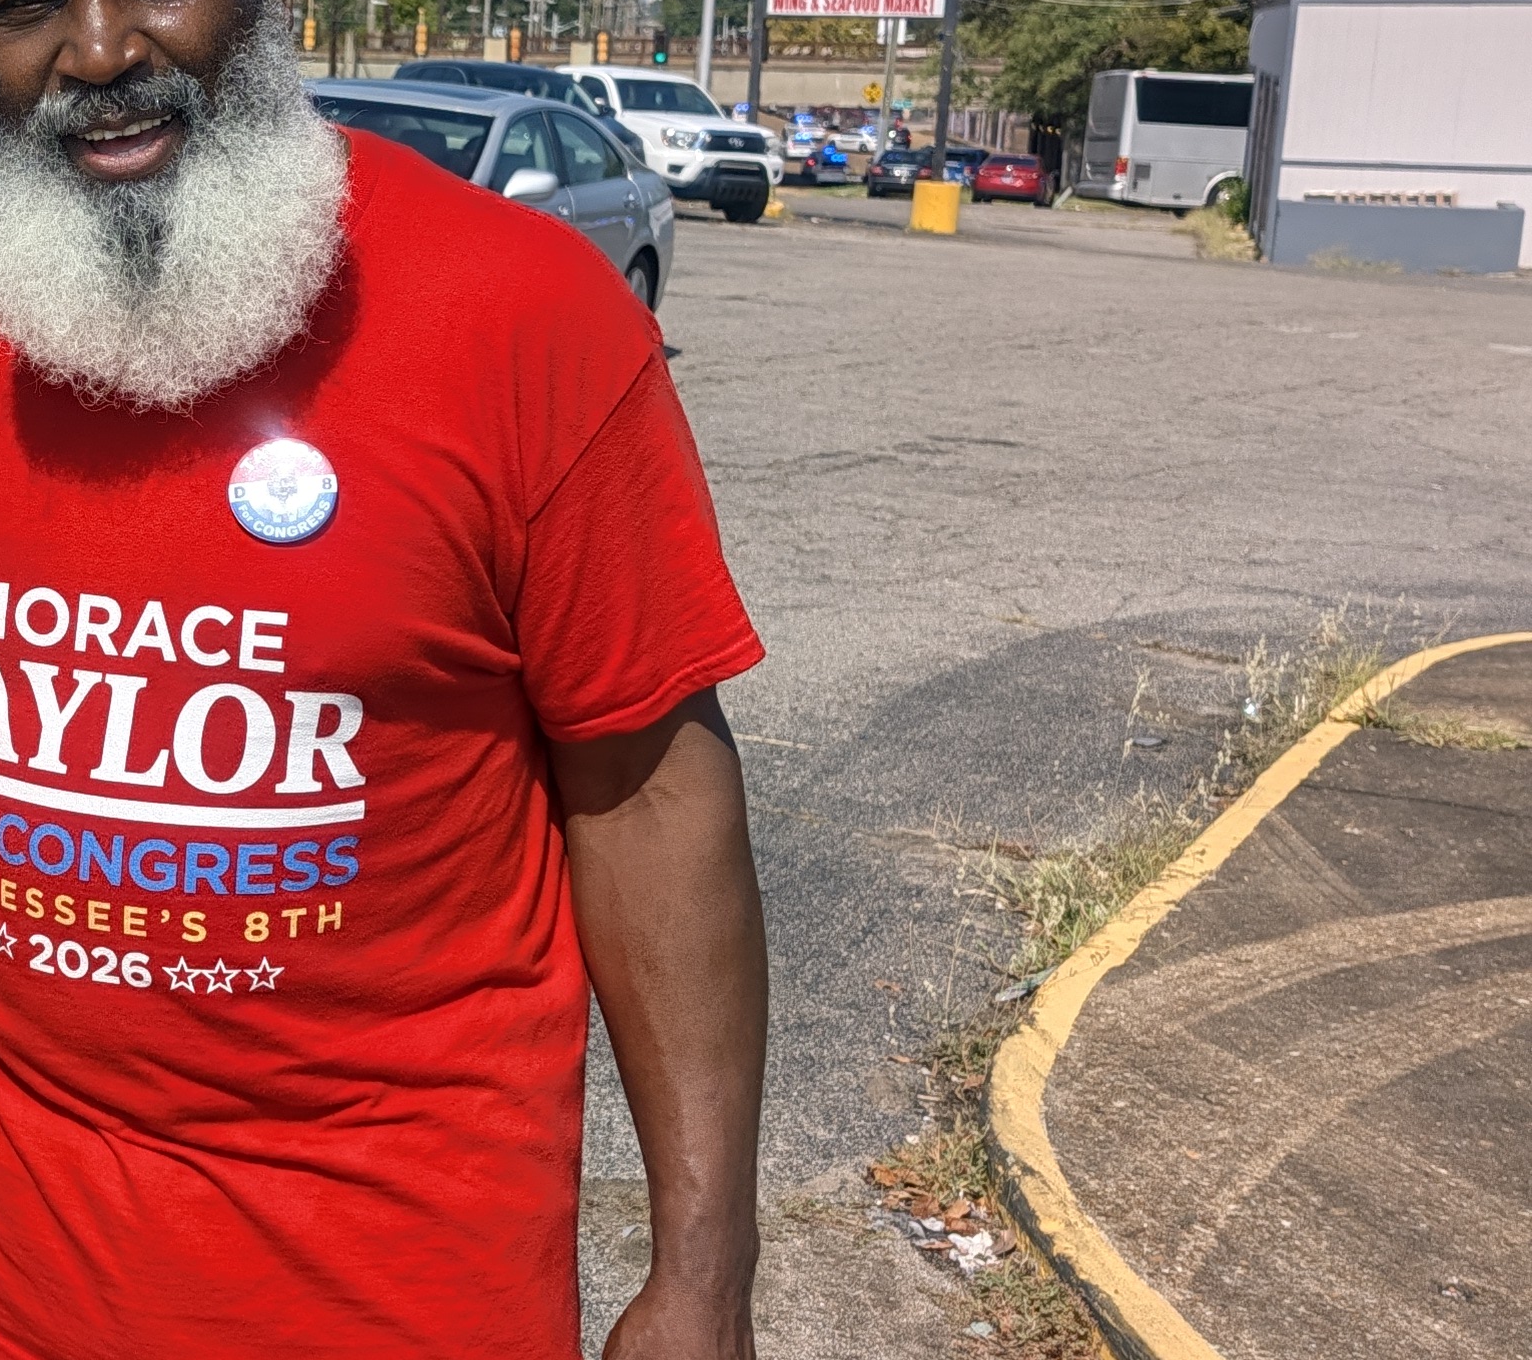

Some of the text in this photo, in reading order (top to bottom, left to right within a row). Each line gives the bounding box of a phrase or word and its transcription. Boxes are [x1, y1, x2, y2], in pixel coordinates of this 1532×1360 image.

[233, 486, 246, 499] D
[321, 477, 332, 490] 8
[253, 500, 331, 538] CONGRESS
[243, 901, 342, 943] 8TH
[28, 934, 153, 988] 2026
